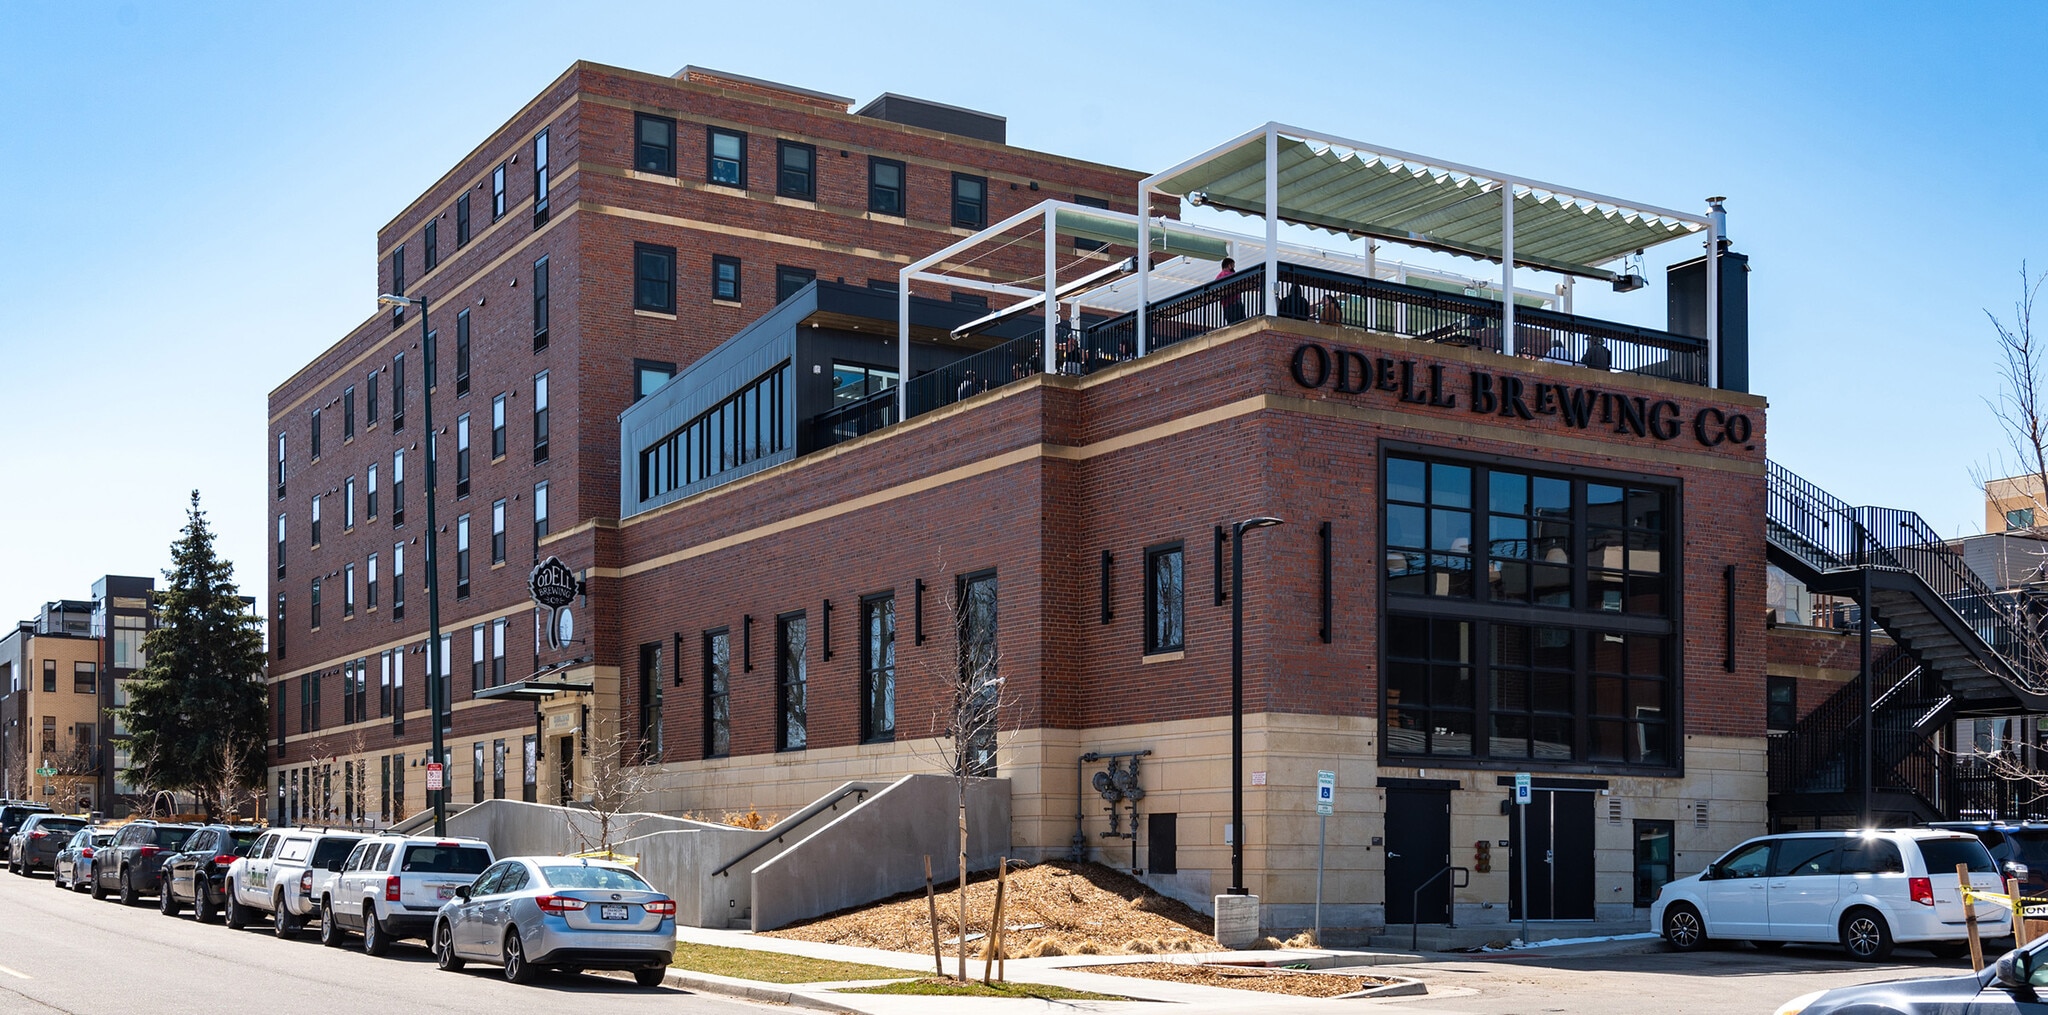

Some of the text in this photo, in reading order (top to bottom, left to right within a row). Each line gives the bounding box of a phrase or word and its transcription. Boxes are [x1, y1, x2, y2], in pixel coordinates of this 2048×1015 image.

[1291, 343, 1455, 408] ODELL
[1471, 371, 1685, 441] BREWING
[538, 565, 572, 590] ODELL
[538, 586, 571, 599] BREWING
